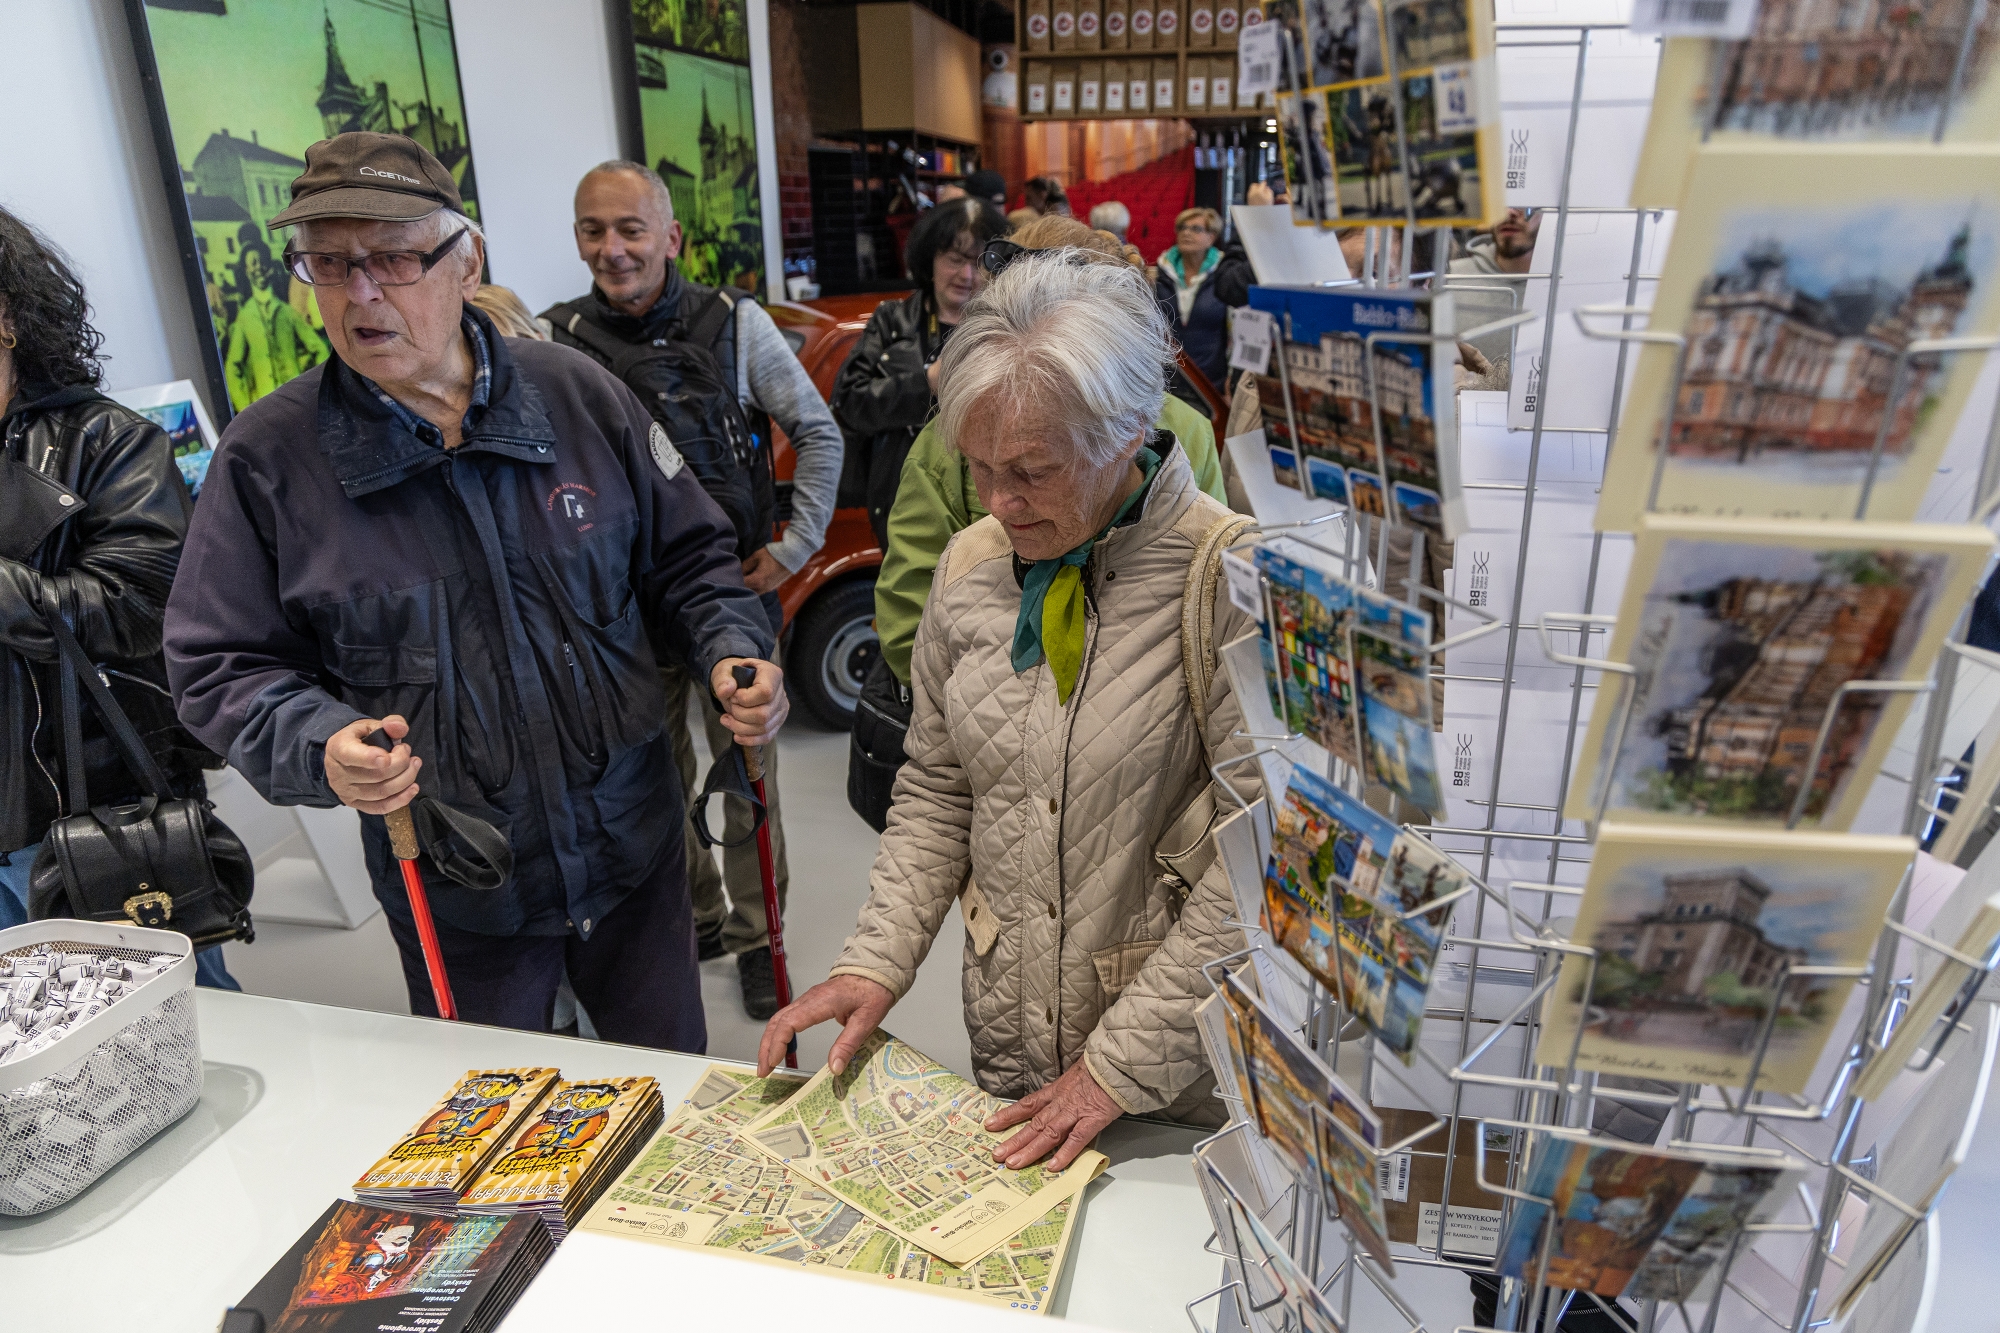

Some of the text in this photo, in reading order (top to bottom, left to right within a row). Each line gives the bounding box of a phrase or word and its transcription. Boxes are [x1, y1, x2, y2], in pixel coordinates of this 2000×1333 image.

[1518, 171, 1526, 189] 2026
[1425, 1209, 1454, 1218] ZESW
[441, 1279, 472, 1287] Beskydy
[410, 1286, 467, 1294] po Euroregionu
[421, 1295, 460, 1303] Cestování
[413, 1317, 445, 1326] Beskidy
[377, 1324, 439, 1333] po Euroregionie
